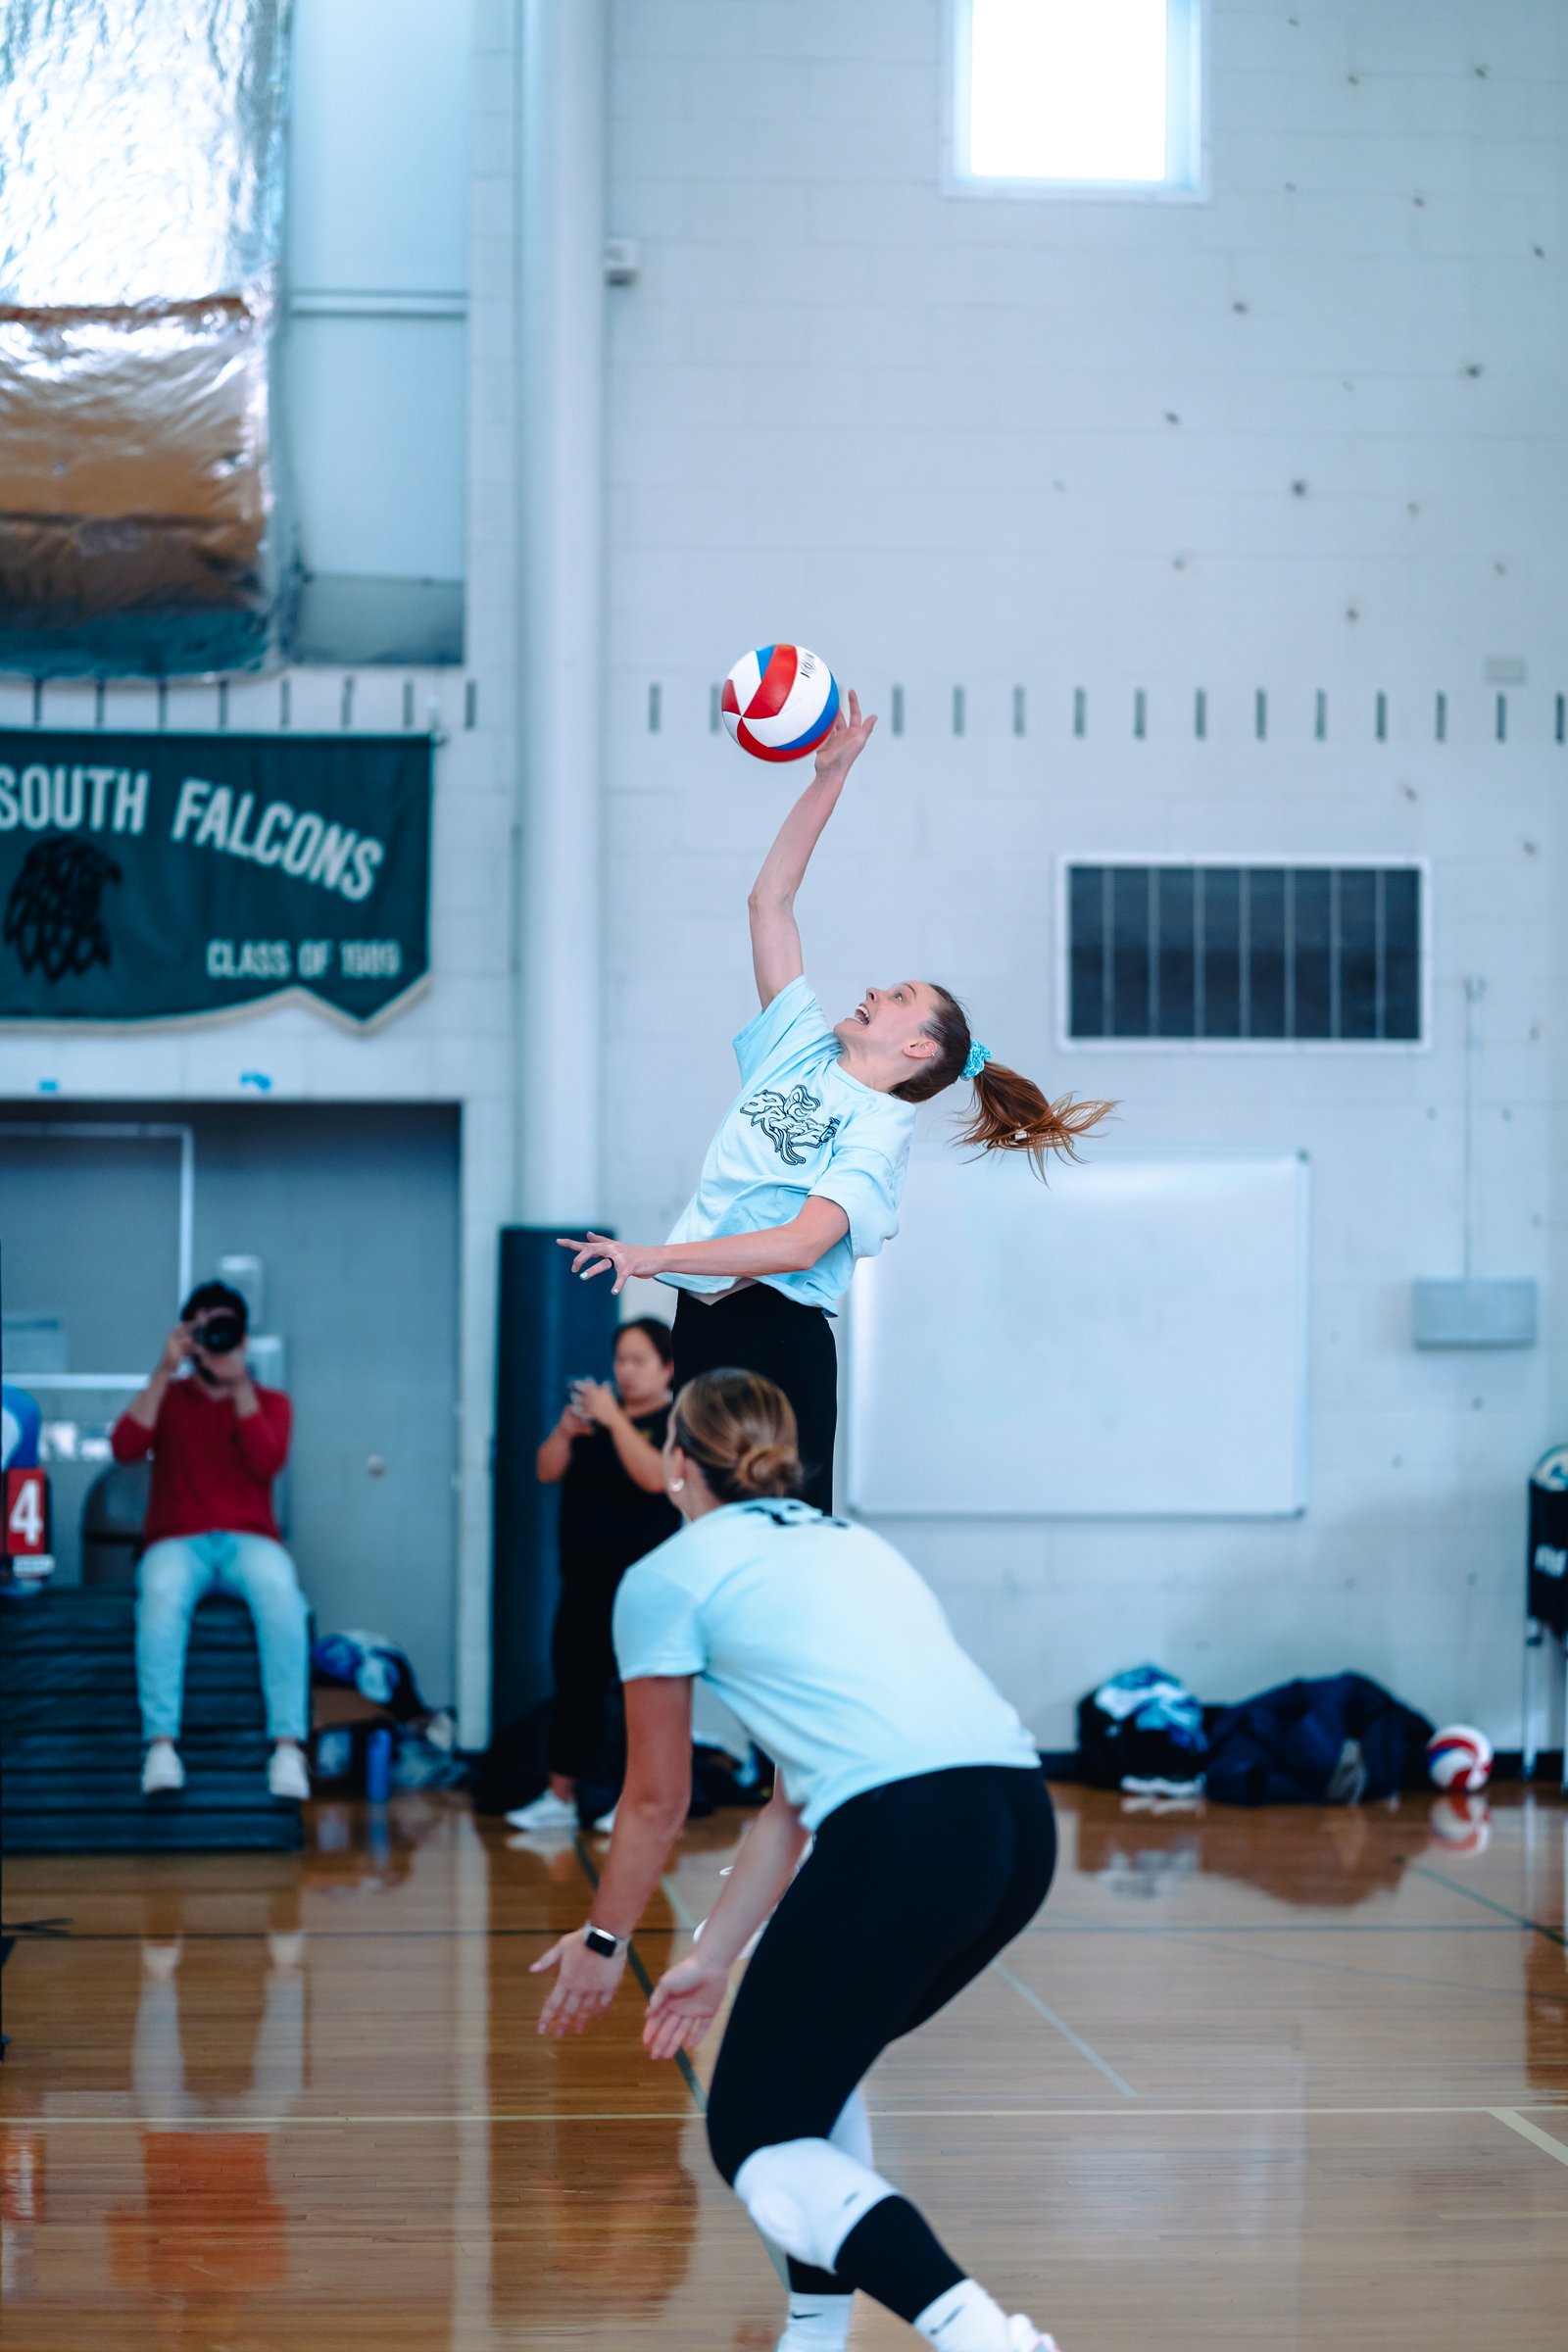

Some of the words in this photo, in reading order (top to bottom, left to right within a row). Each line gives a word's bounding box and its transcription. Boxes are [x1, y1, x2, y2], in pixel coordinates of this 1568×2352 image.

[0, 764, 149, 834] SOUTH
[172, 778, 383, 901] FALCONS
[208, 940, 290, 977] CLASS
[299, 940, 329, 977] OF
[9, 1478, 44, 1546] 4
